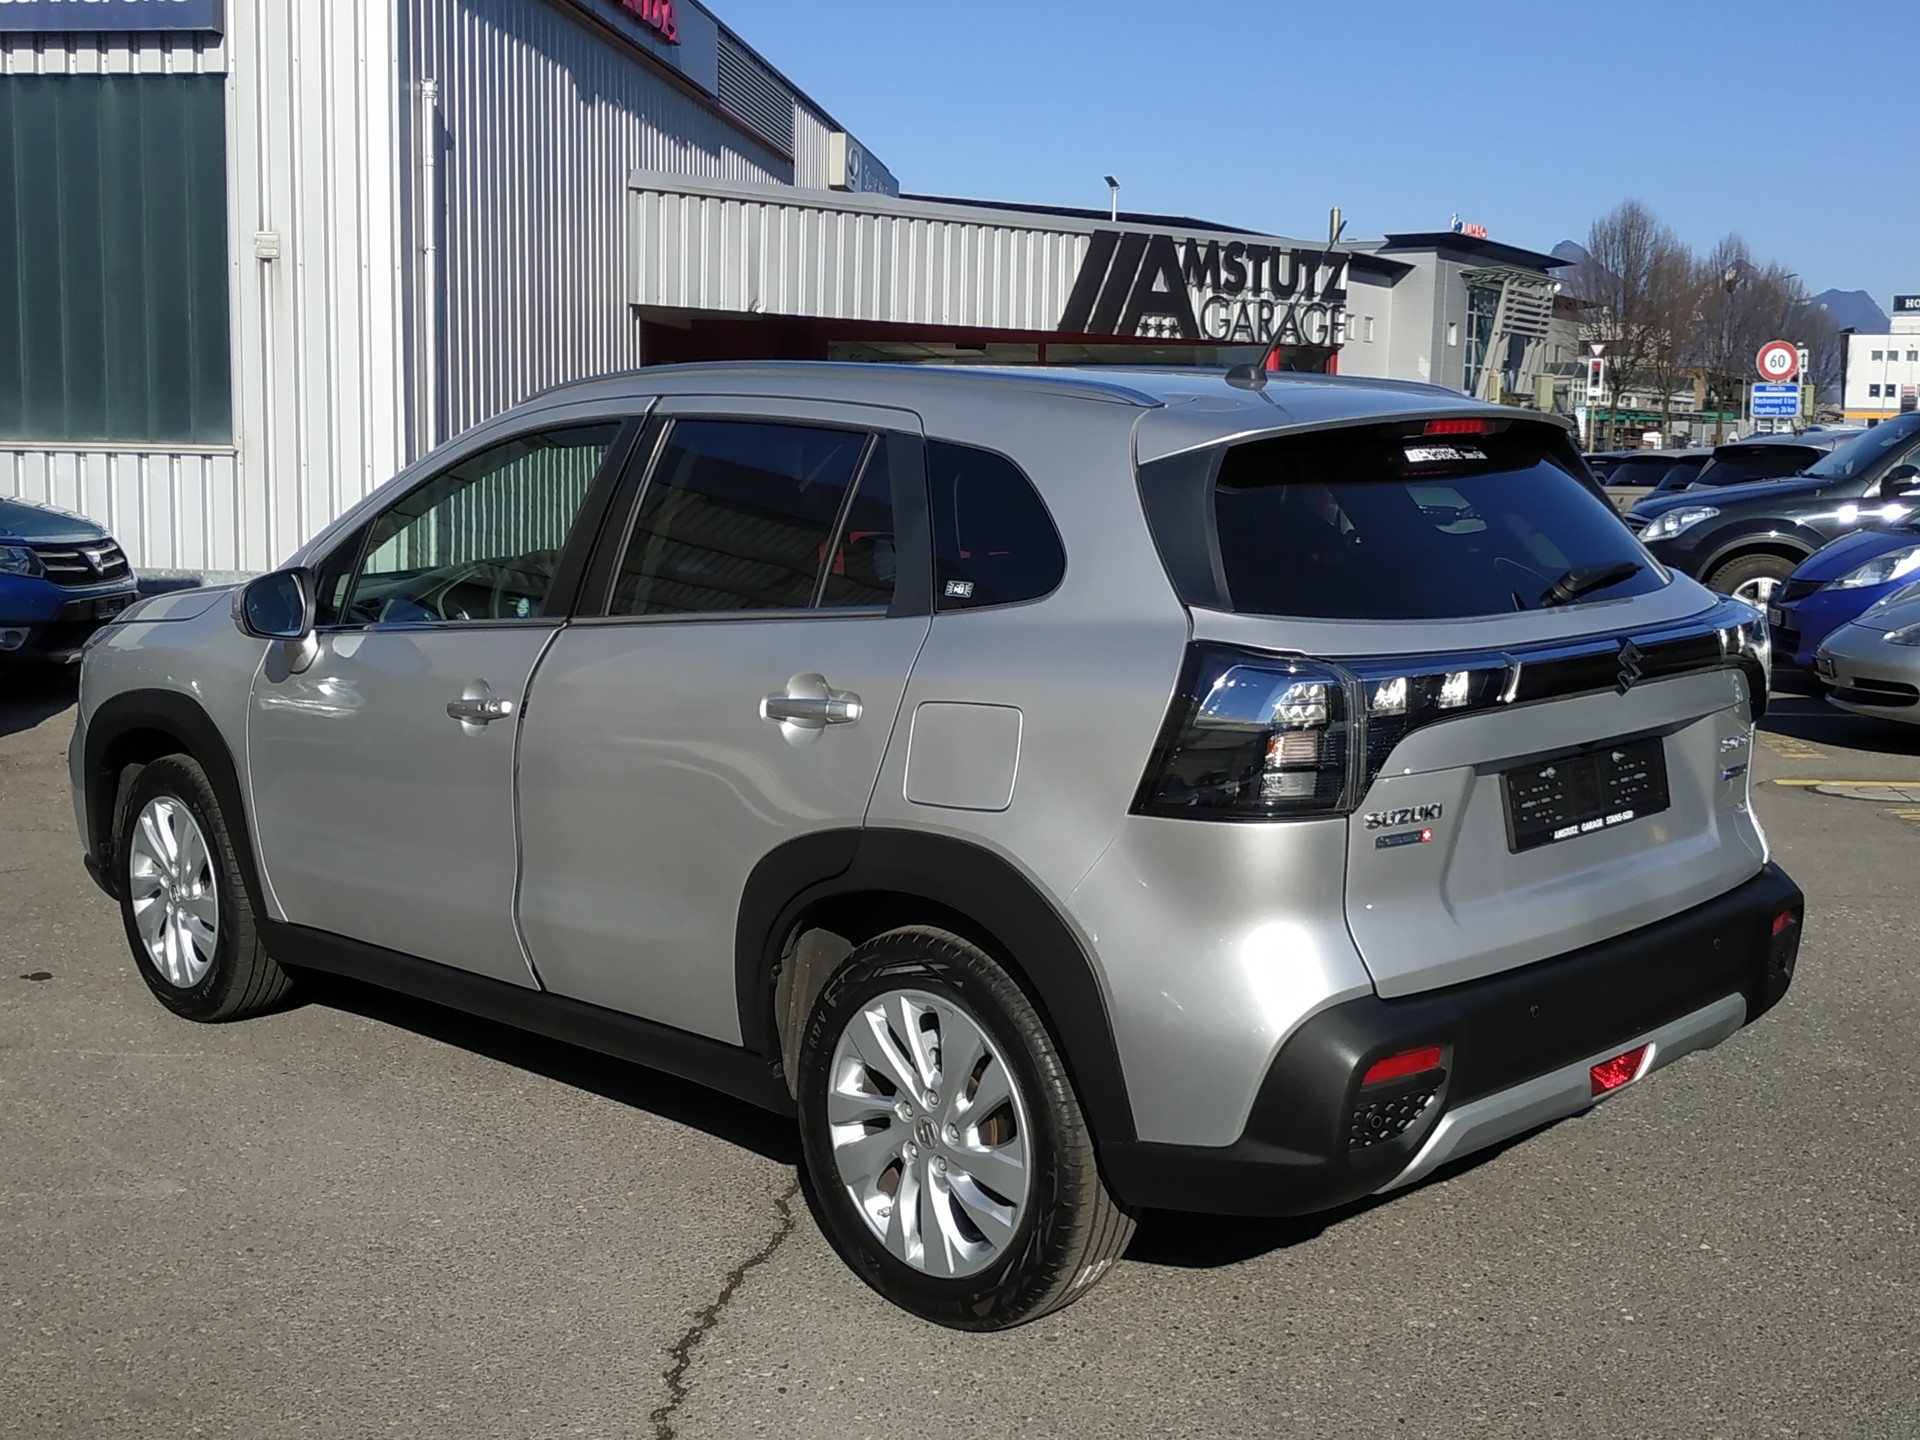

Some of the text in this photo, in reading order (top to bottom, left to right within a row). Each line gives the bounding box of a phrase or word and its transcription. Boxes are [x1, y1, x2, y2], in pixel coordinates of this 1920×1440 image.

[1199, 294, 1347, 347] GARAGE
[1770, 355, 1786, 368] 60
[1363, 802, 1443, 830] SUZUKI
[1581, 817, 1604, 832] GARAGE
